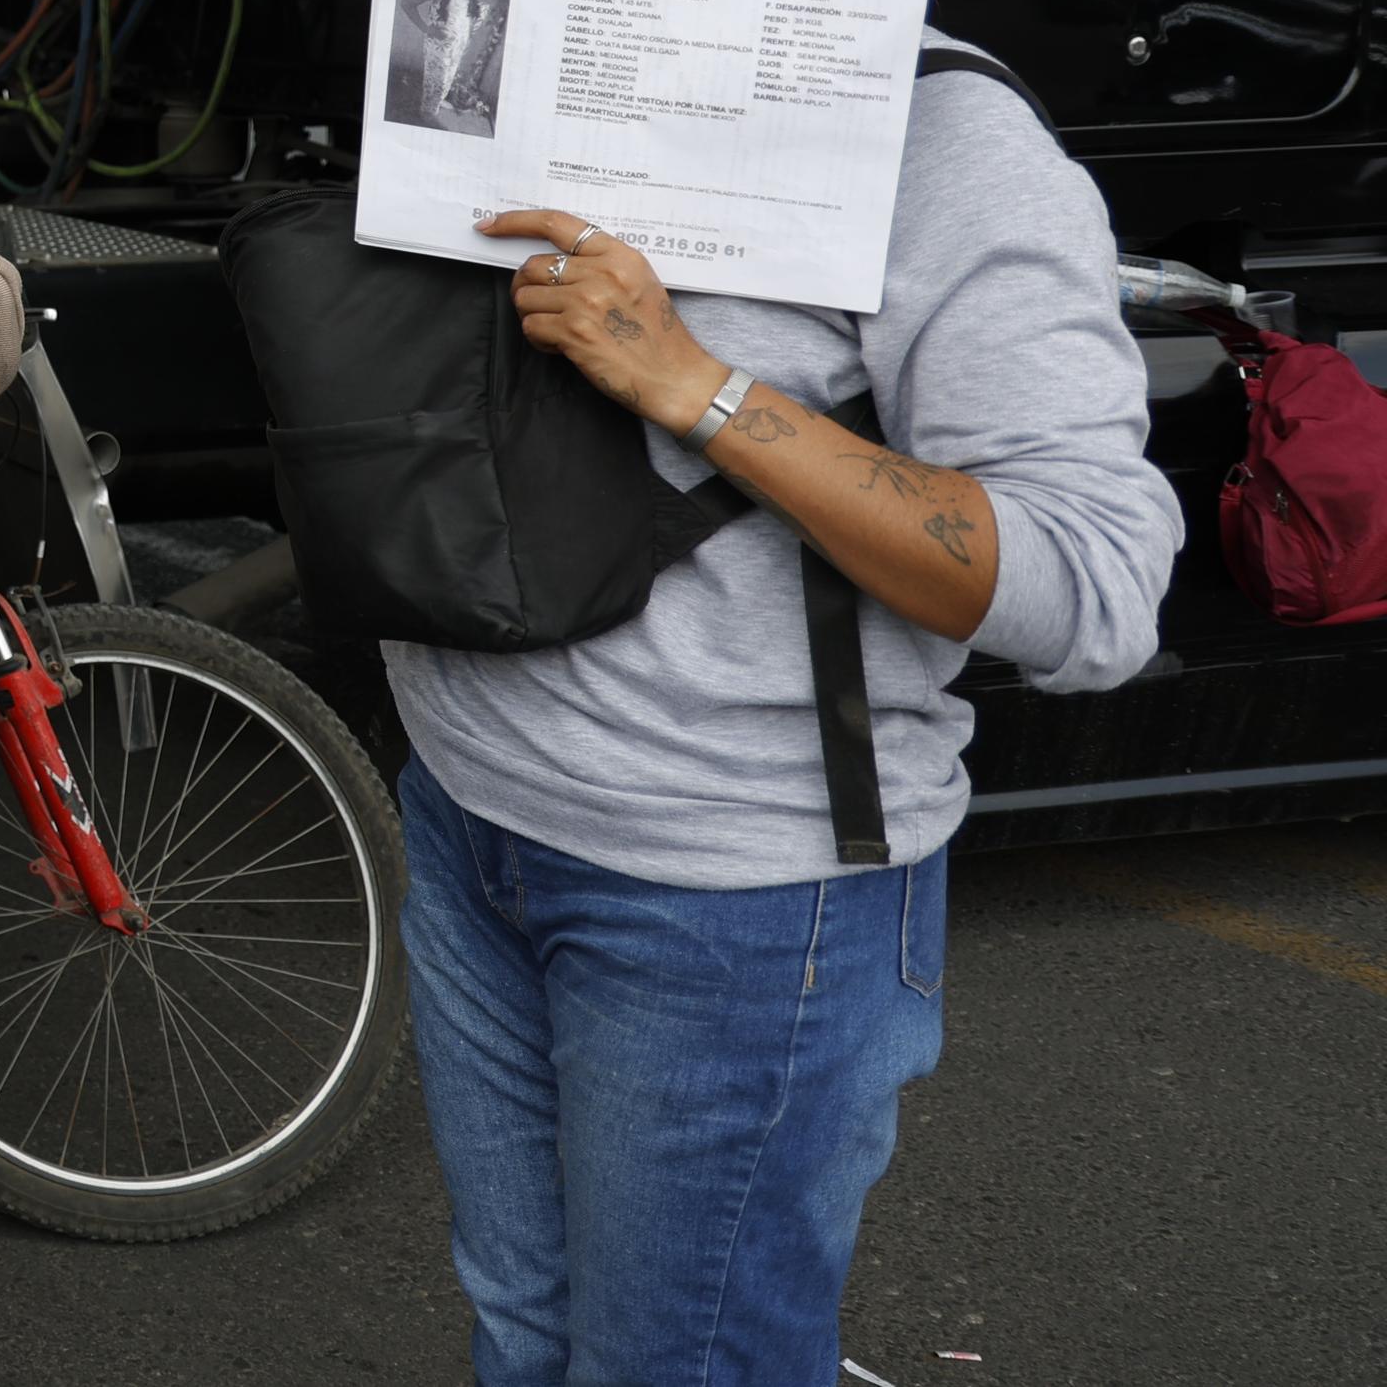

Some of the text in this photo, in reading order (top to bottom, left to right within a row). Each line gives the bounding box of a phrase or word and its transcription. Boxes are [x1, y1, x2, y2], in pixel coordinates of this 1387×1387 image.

[473, 207, 746, 259] 80 800 216 03 61
